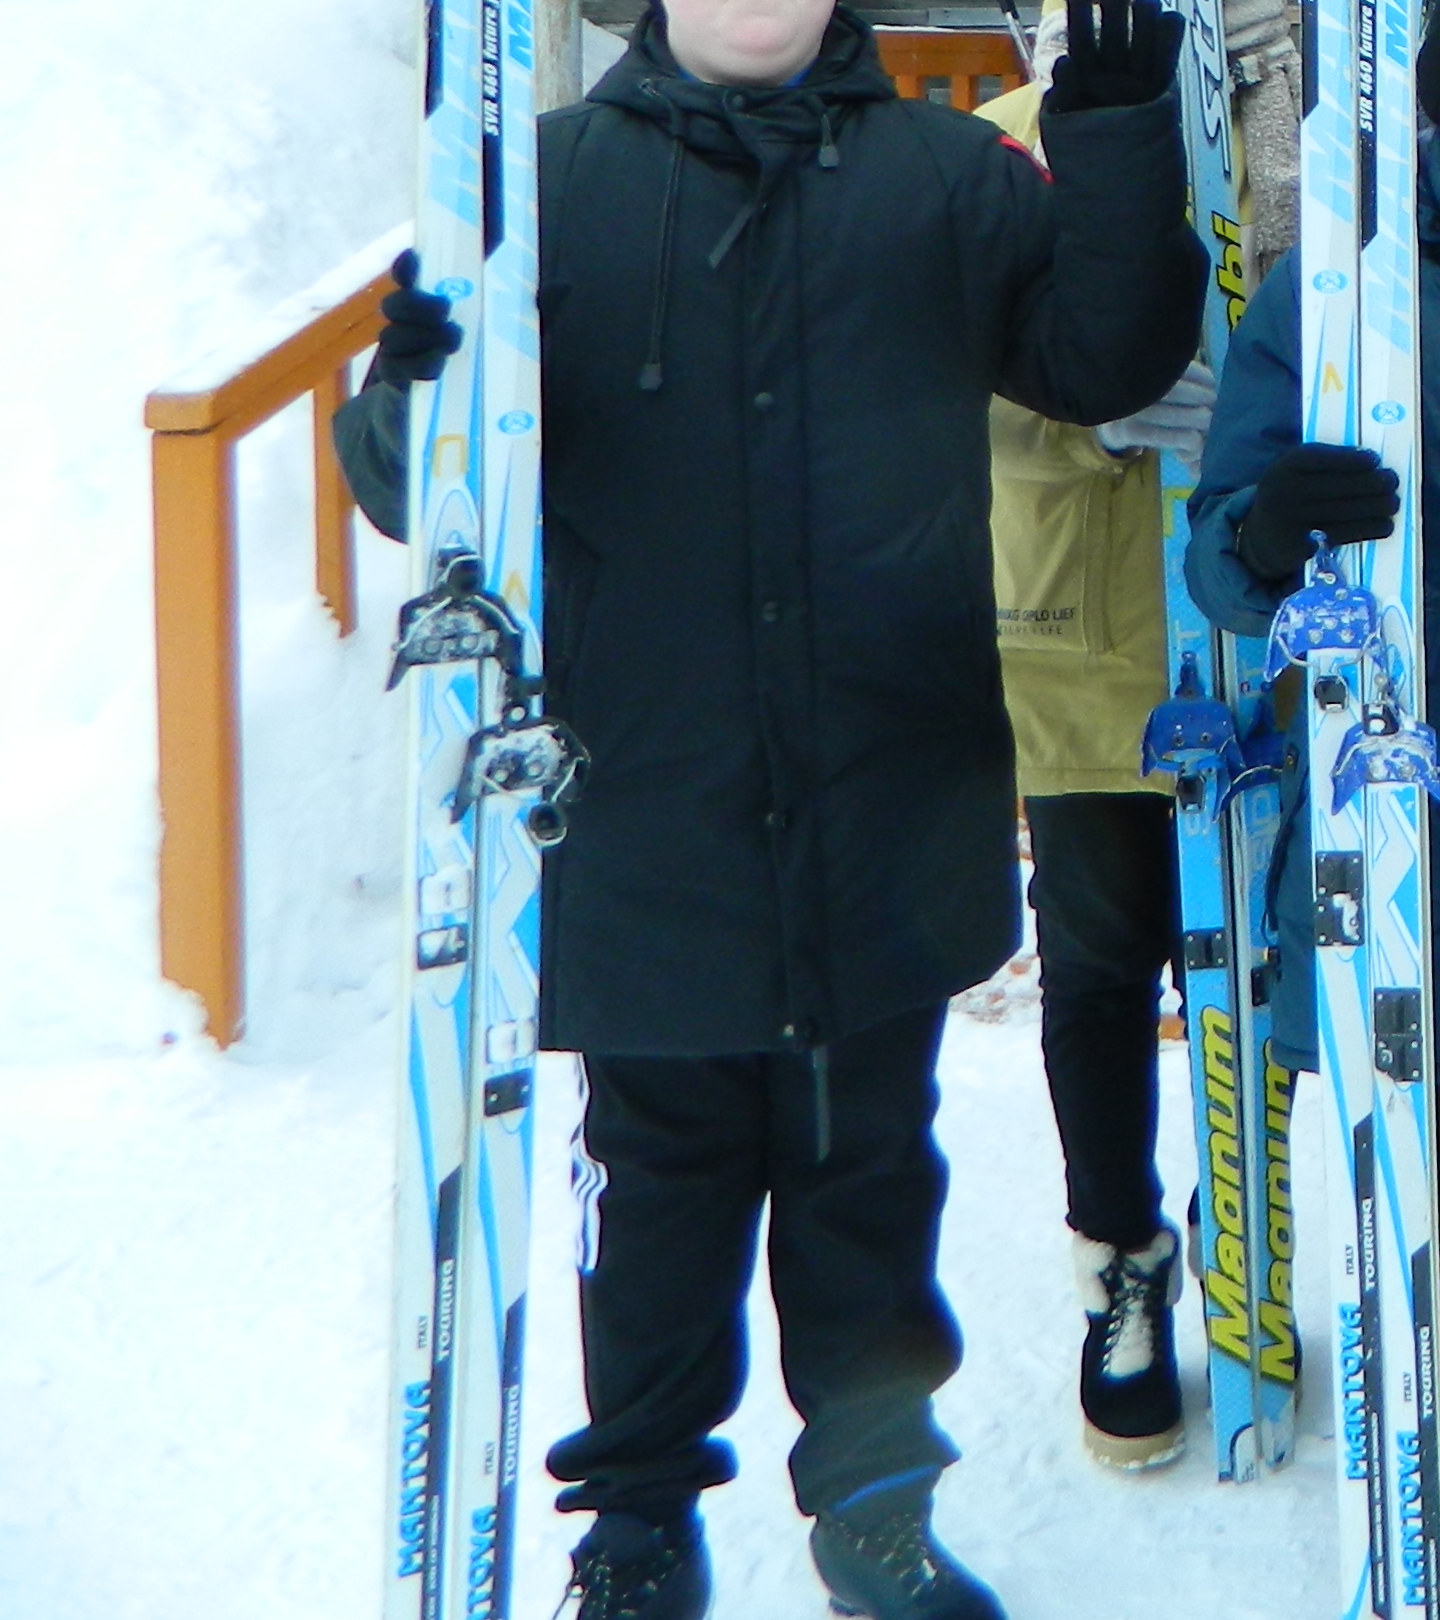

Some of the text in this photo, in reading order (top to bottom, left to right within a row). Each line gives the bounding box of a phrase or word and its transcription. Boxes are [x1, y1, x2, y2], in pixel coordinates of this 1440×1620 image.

[482, 7, 498, 61] future
[1359, 6, 1374, 59] future
[483, 63, 498, 97] 460
[1360, 61, 1374, 94] 460
[483, 100, 498, 136] SVR
[1360, 97, 1374, 132] SVR
[1344, 1244, 1355, 1276] ITALY
[1361, 1198, 1377, 1292] TOURING
[417, 1315, 427, 1350] ITALY
[436, 1259, 455, 1363] TOURING
[1337, 1302, 1368, 1481] MANTOVA
[1402, 1372, 1412, 1403] ITALY
[1418, 1326, 1433, 1419] TOURING
[483, 1441, 494, 1476] ITALY
[502, 1385, 521, 1487] TOURING
[397, 1380, 430, 1578] MANTOVA
[1396, 1430, 1427, 1607] MANTOVA
[466, 1506, 498, 1620] TOVA
